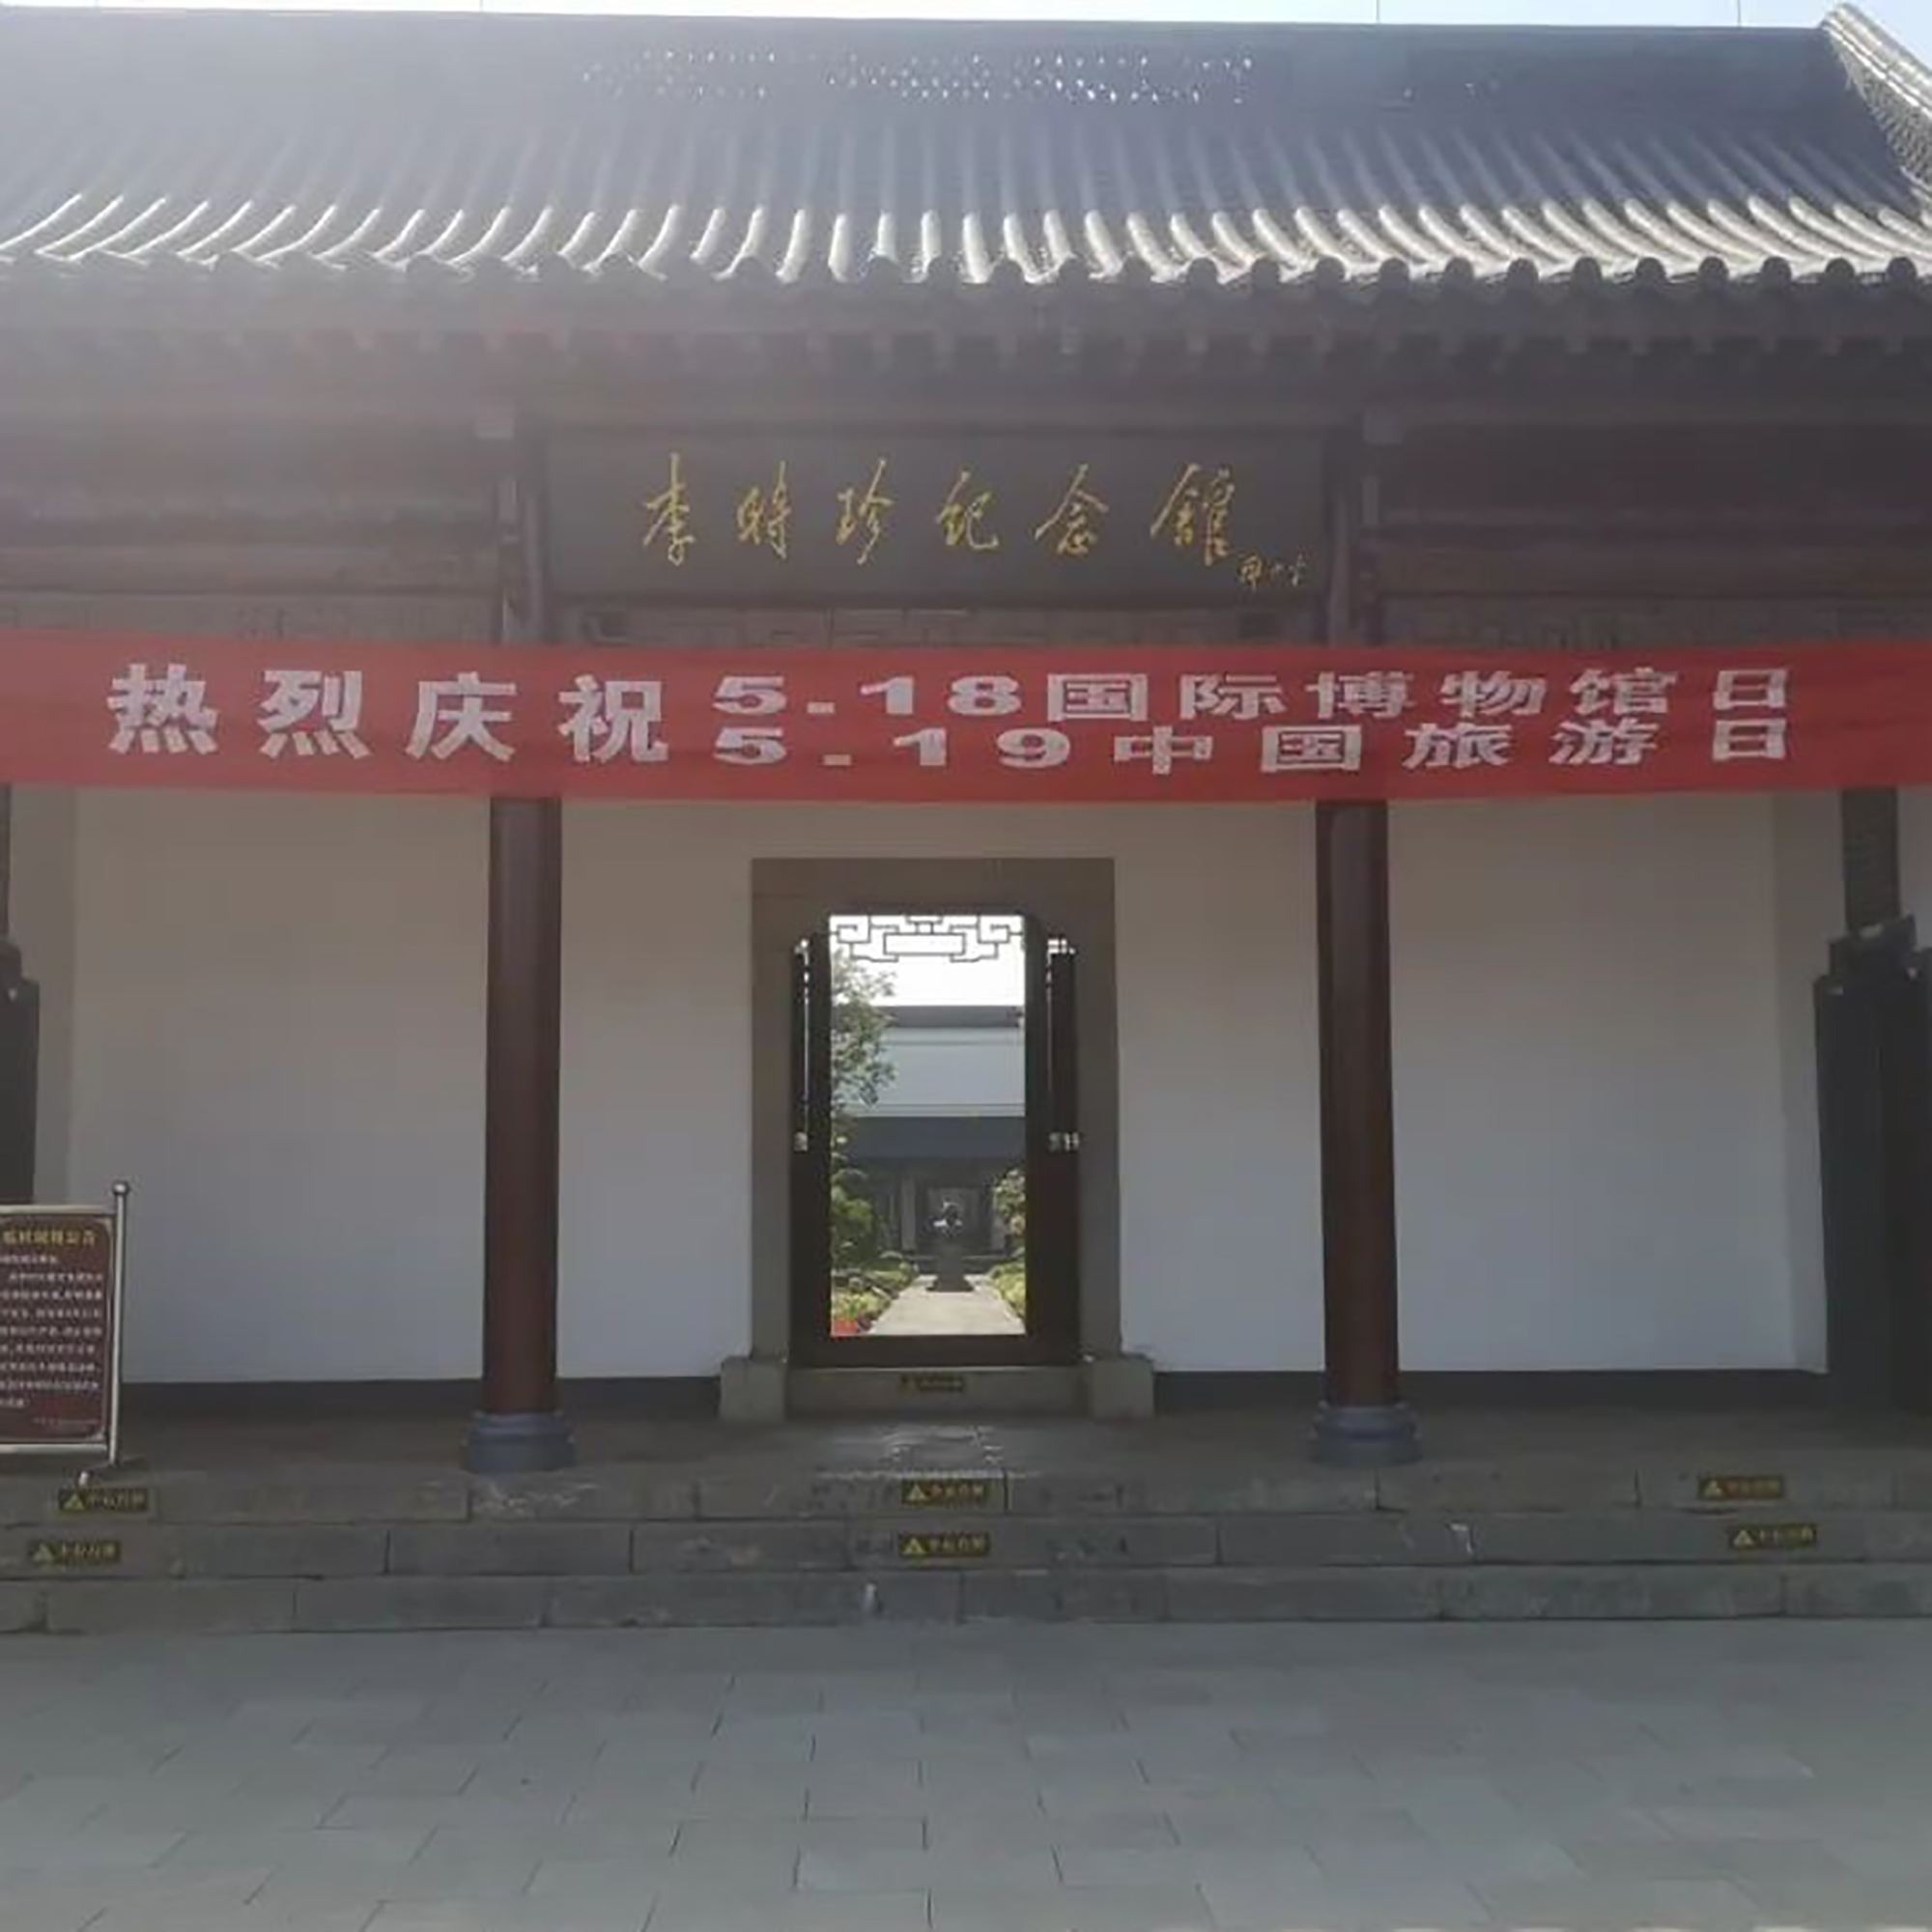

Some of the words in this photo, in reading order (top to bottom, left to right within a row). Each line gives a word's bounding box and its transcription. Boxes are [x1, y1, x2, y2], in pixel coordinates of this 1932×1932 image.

[107, 663, 669, 760] 热烈庆祝
[712, 719, 1790, 776] 5.19中国旅游日
